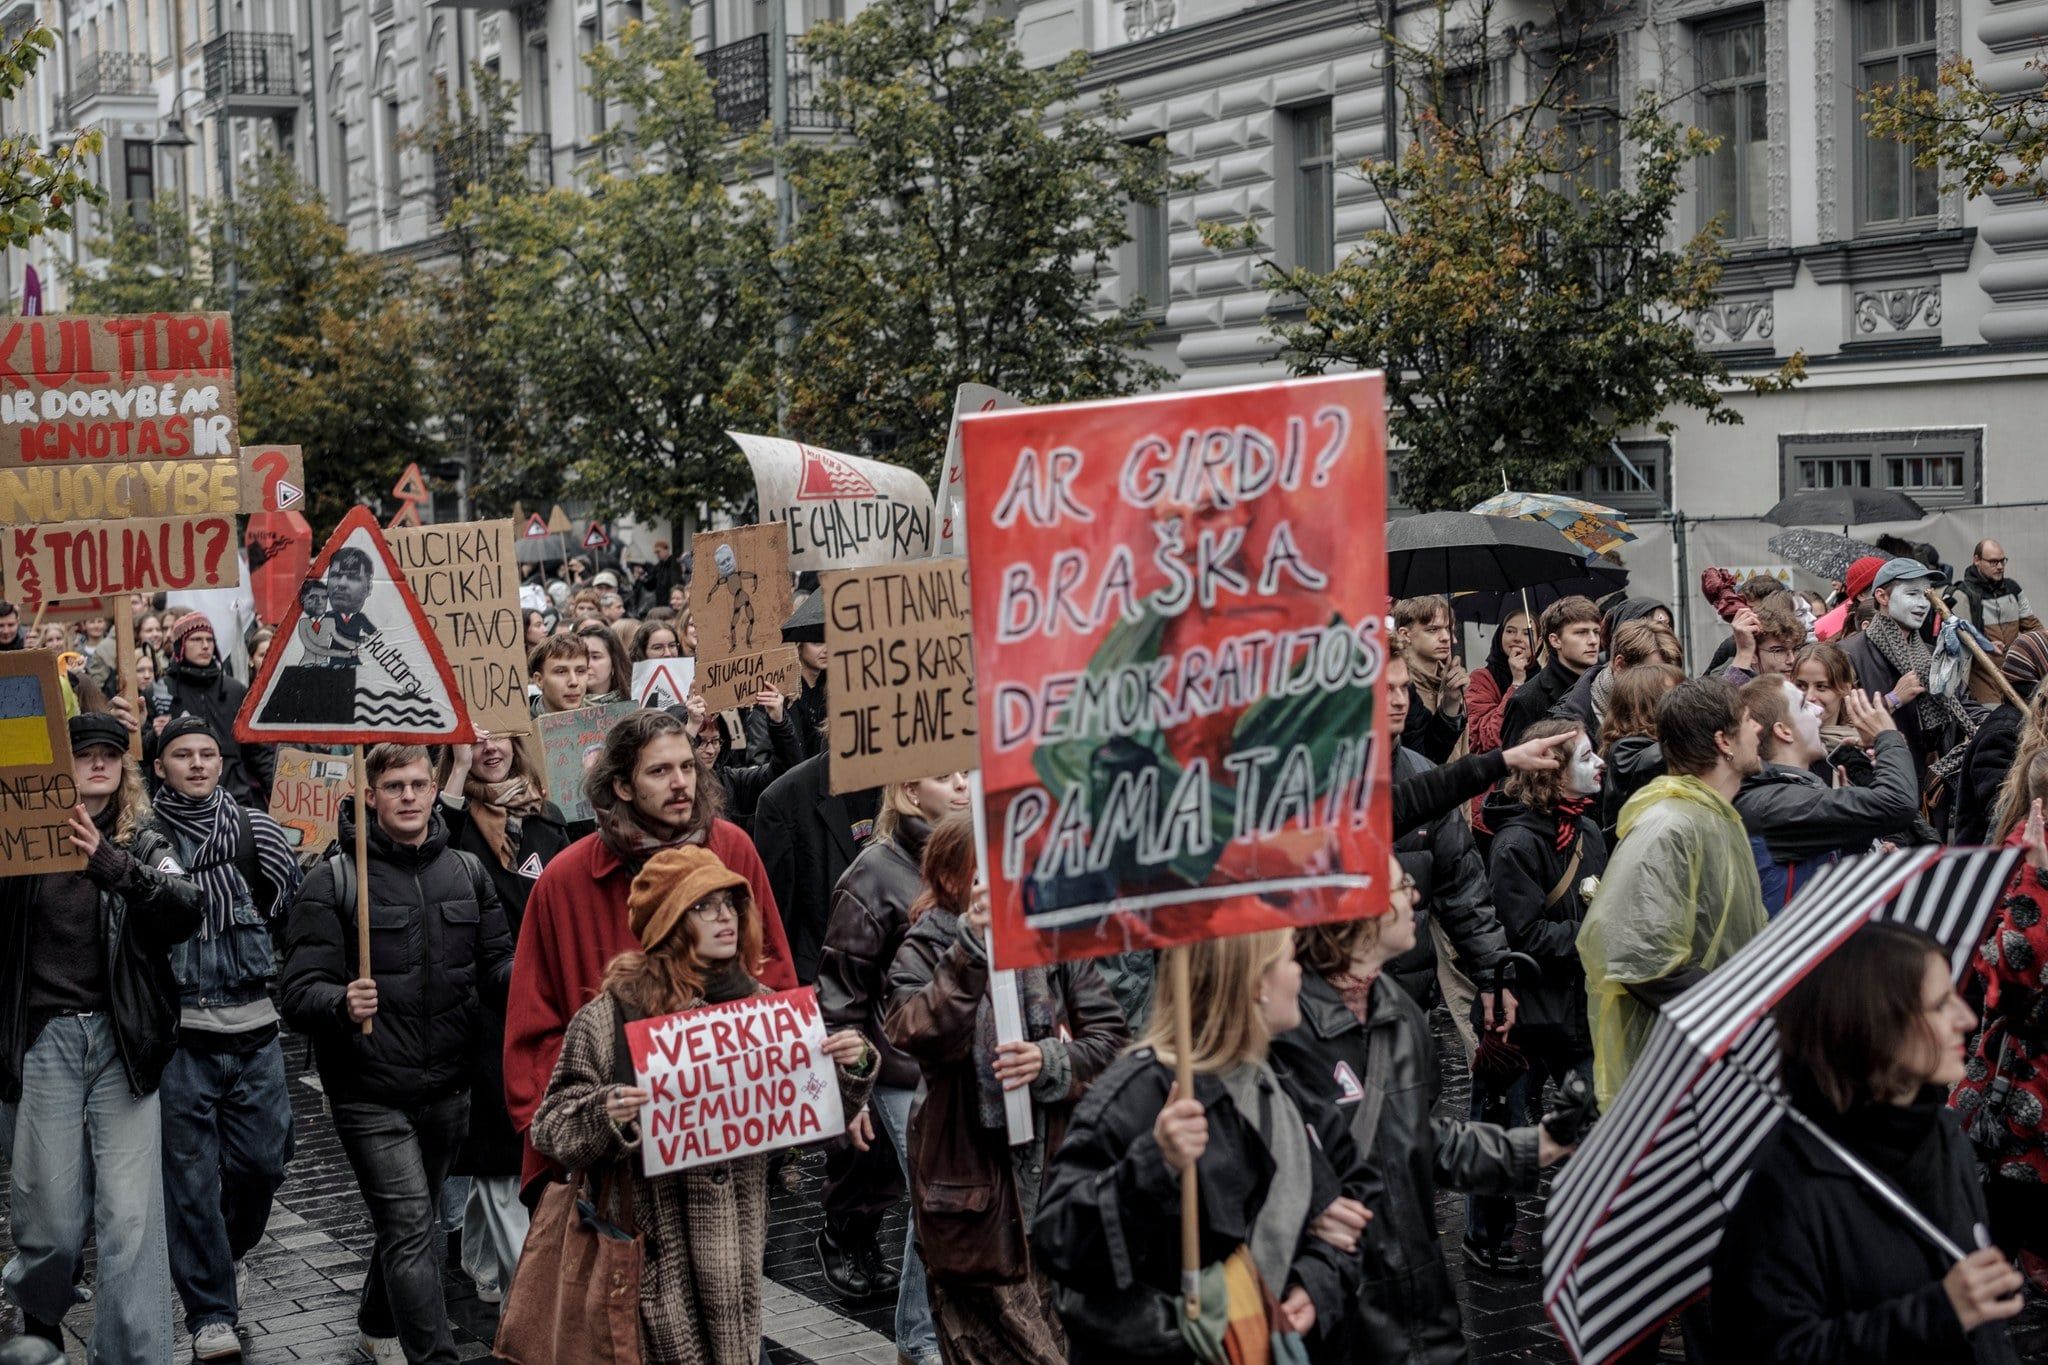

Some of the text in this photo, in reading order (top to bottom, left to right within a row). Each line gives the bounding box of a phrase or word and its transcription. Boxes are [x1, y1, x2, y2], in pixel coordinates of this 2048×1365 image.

[0, 312, 231, 392] KULTŪRA
[0, 389, 39, 424] IR
[180, 385, 219, 414] AR
[20, 414, 233, 462] IGNOTAS IR
[993, 446, 1095, 528] AR
[1119, 405, 1350, 509] GIRDI?
[44, 518, 230, 595] TOLIAU?
[386, 528, 500, 568] IUCIKAI
[997, 520, 1328, 644] BRAŠKA
[445, 608, 518, 649] TAVO
[834, 638, 911, 692] TRIS
[994, 615, 1384, 754] DEMOKRATIJOS
[840, 705, 883, 759] JIE
[1003, 732, 1378, 881] PAMATAI!
[656, 1008, 802, 1067] VERKIA
[651, 1041, 811, 1104] KULTŪRA
[652, 1078, 796, 1137] NEMUNO
[658, 1103, 821, 1166] VALDOMA
